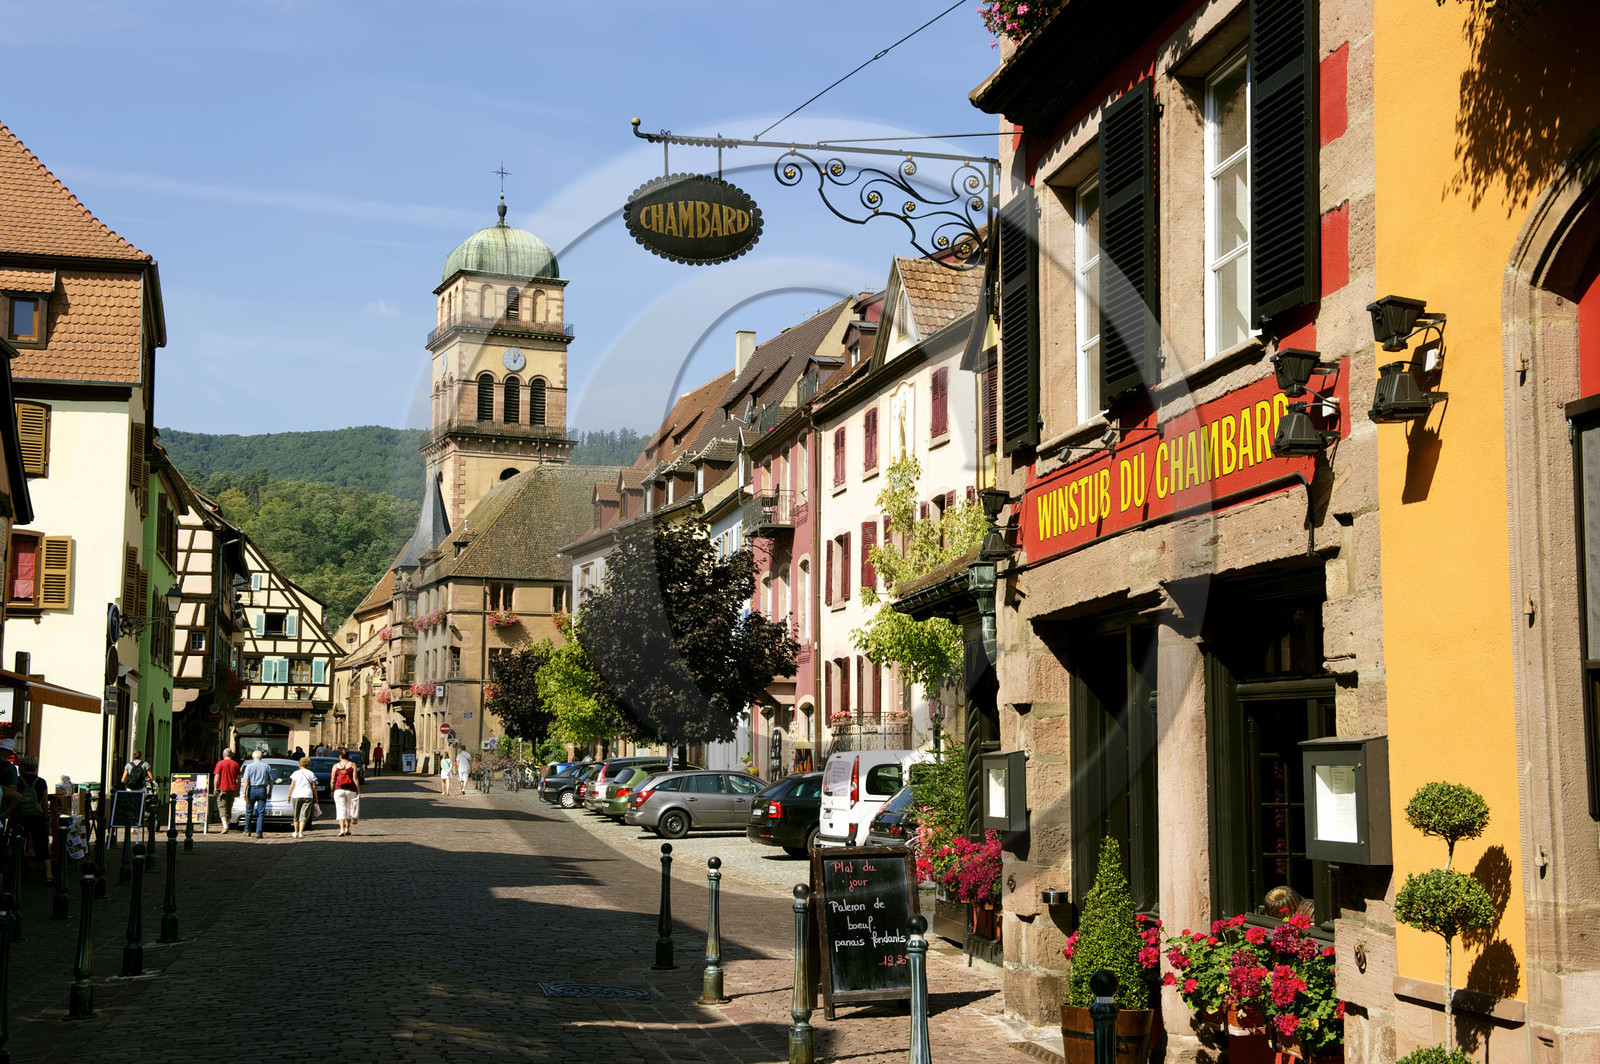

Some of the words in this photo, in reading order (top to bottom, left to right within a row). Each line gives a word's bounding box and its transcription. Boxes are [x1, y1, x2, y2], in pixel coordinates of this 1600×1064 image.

[640, 201, 749, 238] CHAMBARD
[1037, 469, 1111, 541] WINSTUB
[1120, 452, 1145, 512] DU
[830, 861, 854, 873] Plat
[863, 860, 877, 872] du
[849, 876, 869, 892] jour
[828, 899, 866, 913] Paleron
[874, 898, 885, 909] de
[834, 936, 865, 952] panais
[871, 929, 907, 948] fondants
